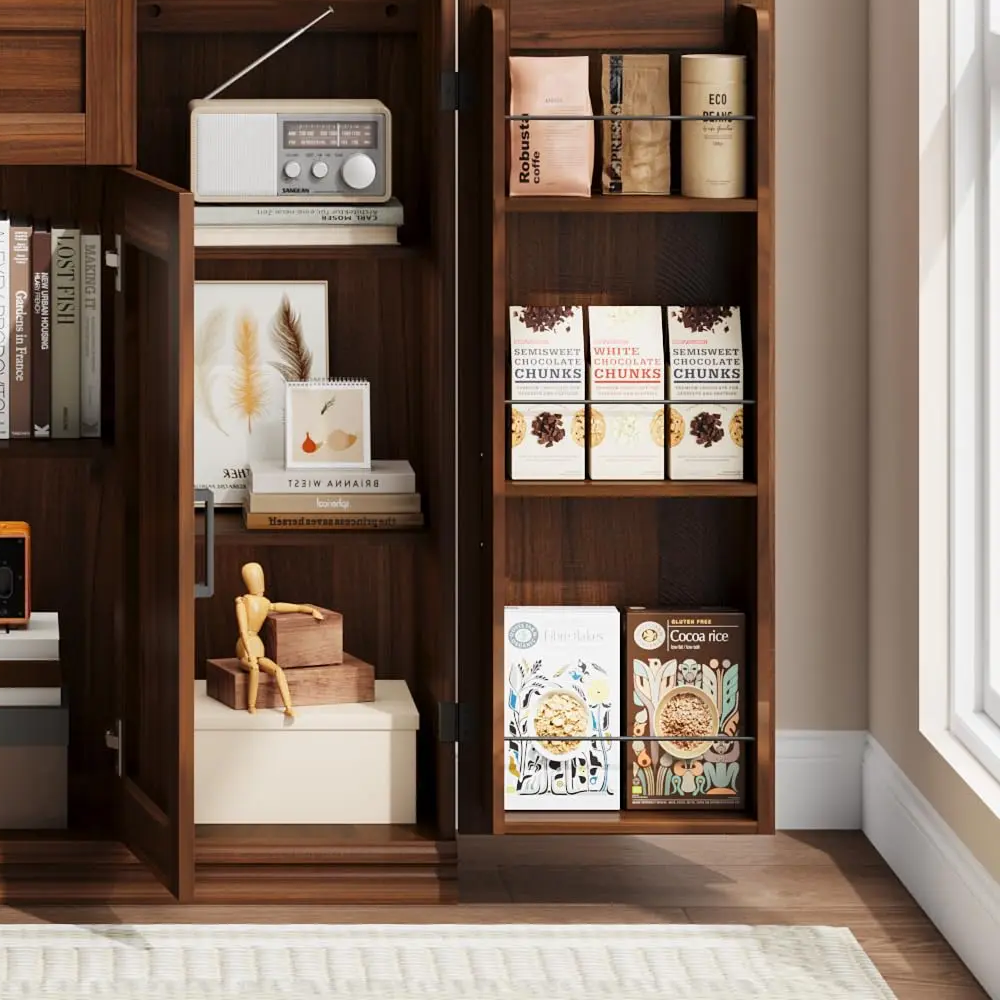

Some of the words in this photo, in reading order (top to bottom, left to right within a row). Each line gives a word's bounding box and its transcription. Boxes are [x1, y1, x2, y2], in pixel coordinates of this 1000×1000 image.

[709, 93, 727, 105] ECO
[531, 151, 541, 184] coffe
[56, 236, 78, 282] LOST
[84, 244, 96, 294] MAKING
[41, 272, 49, 289] NEW
[41, 290, 49, 316] URBAN
[56, 285, 78, 325] FISH
[84, 297, 96, 311] IT
[15, 290, 28, 332] Gardens
[15, 334, 28, 345] in
[41, 317, 49, 350] HOUSING
[514, 348, 581, 356] SEMISWEET
[593, 347, 640, 356] WHITE
[672, 348, 739, 356] SEMISWEET
[15, 346, 28, 382] France
[514, 358, 582, 366] CHOCOLATE
[594, 358, 661, 366] CHOCOLATE
[673, 358, 741, 366] CHOCOLATE
[514, 368, 582, 379] CHUNKS
[594, 368, 661, 379] CHUNKS
[673, 368, 741, 379] CHUNKS
[670, 629, 706, 642] Cocoa
[708, 629, 729, 642] rice
